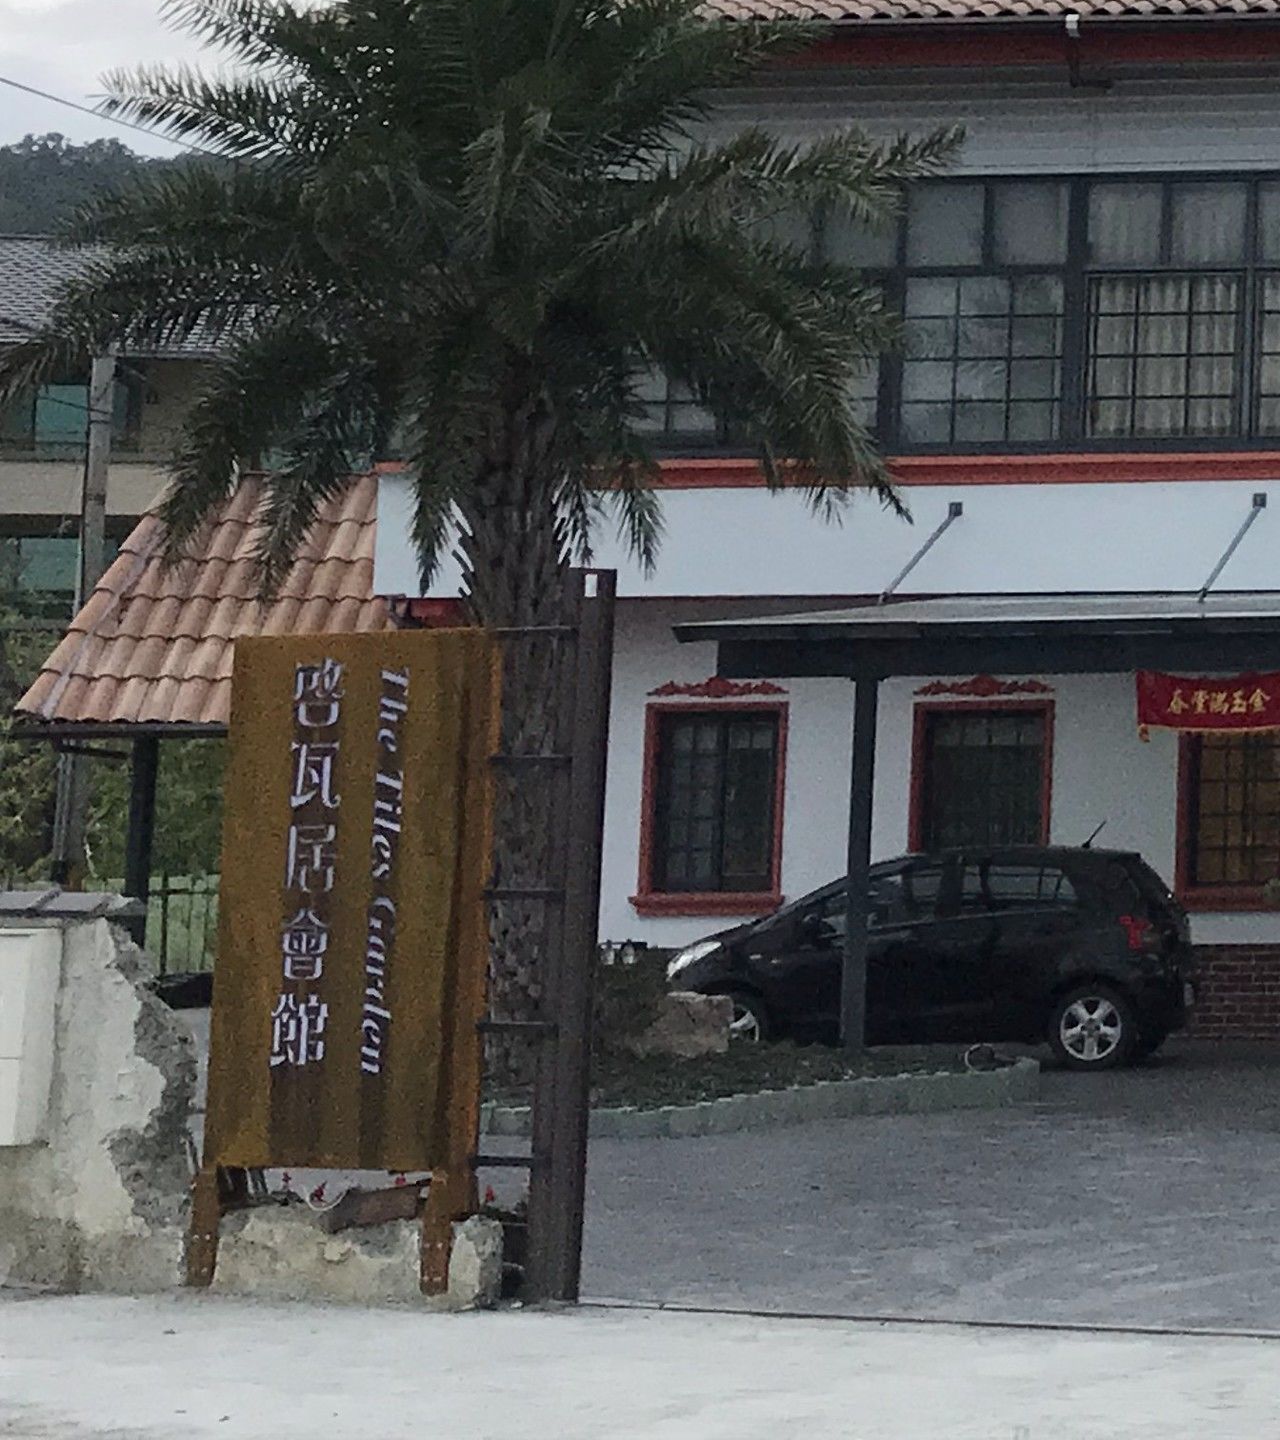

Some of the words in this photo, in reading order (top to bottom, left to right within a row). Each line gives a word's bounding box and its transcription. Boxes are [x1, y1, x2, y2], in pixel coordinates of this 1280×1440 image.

[376, 666, 411, 753] The
[370, 769, 405, 881] Tiles
[360, 896, 398, 1075] Garden
